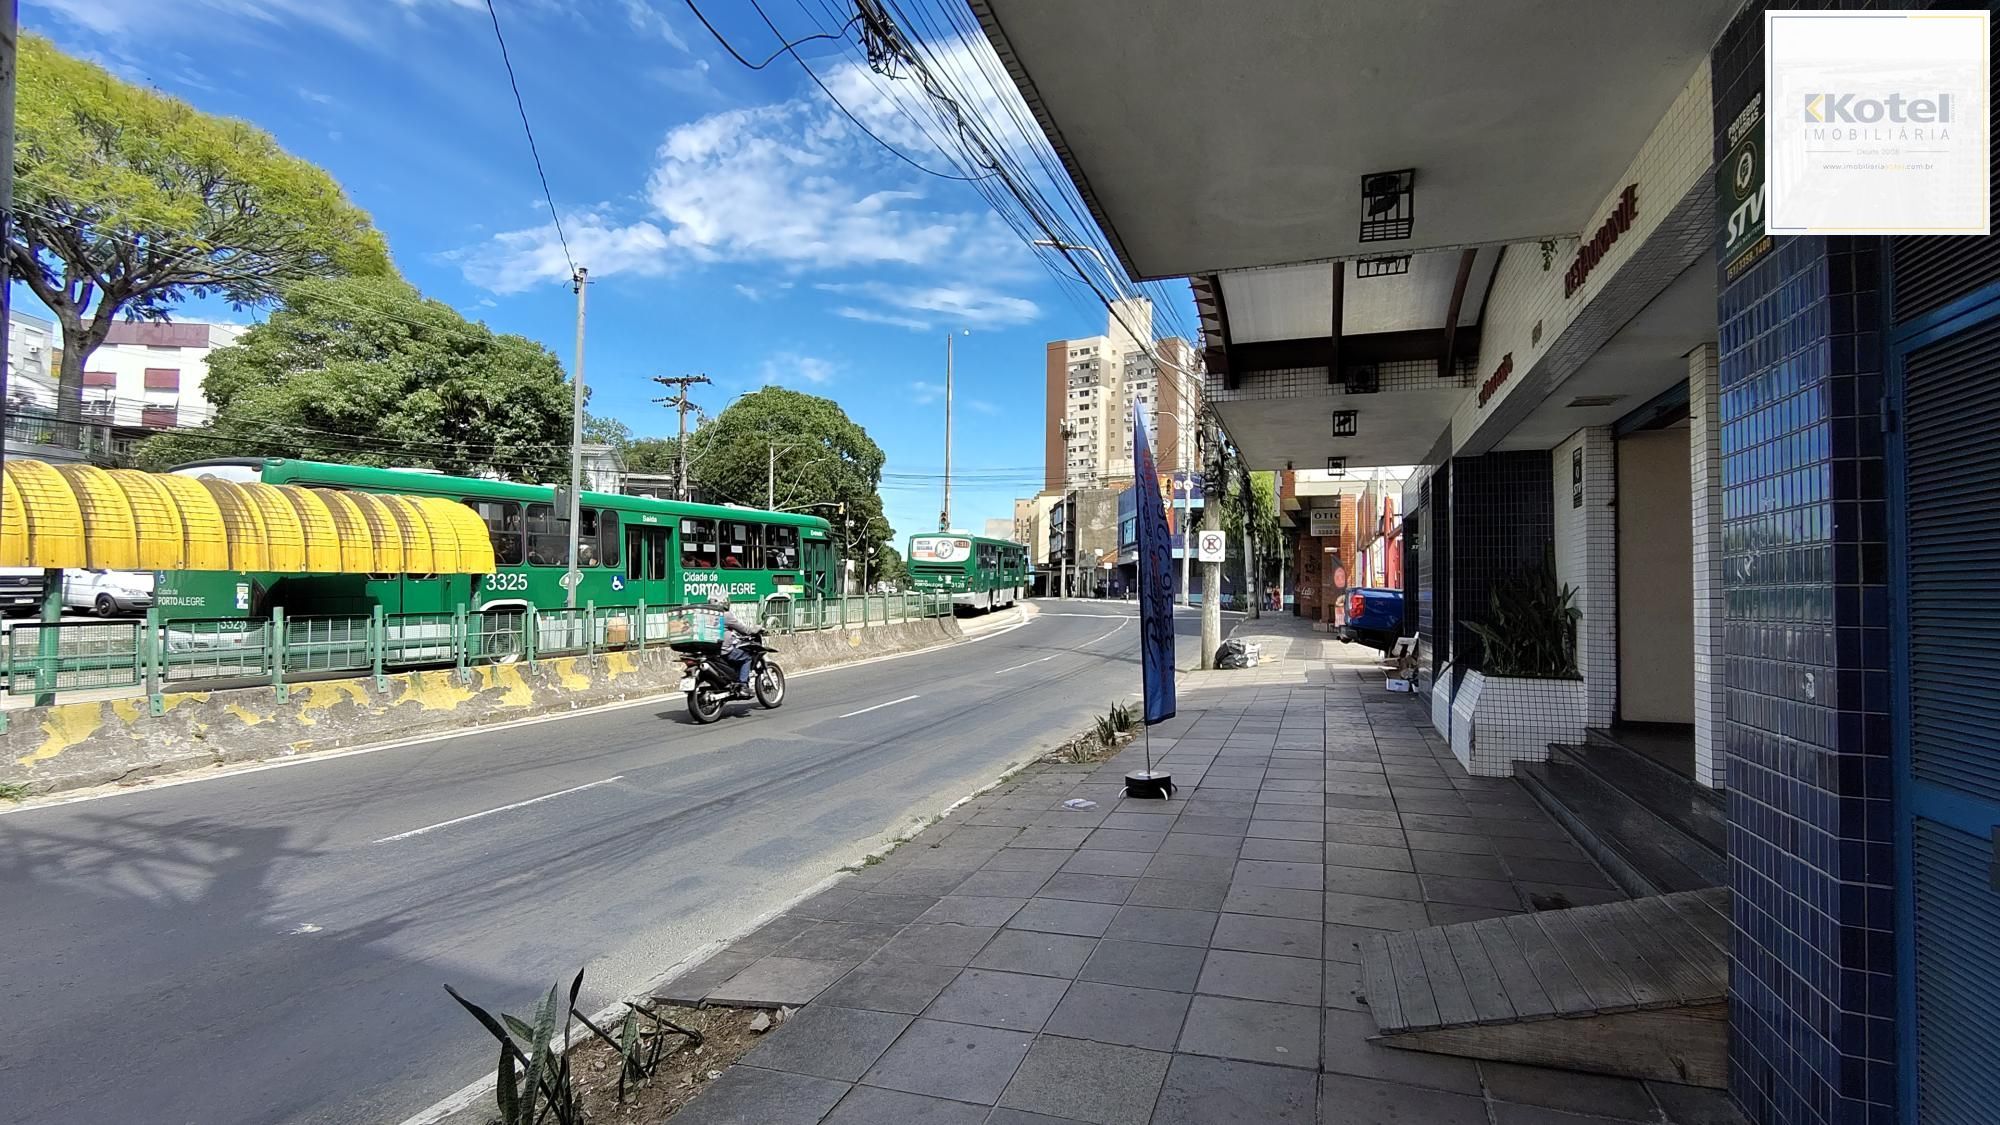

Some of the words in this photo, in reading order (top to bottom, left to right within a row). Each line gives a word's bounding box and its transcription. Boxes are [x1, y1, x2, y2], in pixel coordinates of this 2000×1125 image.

[1728, 93, 1761, 139] PROTEGIDO
[1738, 109, 1759, 138] HORAS
[1726, 182, 1765, 249] STV
[1564, 183, 1639, 299] RESTAURANTE
[486, 573, 528, 591] 3325
[683, 572, 708, 582] Cidade
[709, 571, 718, 581] de
